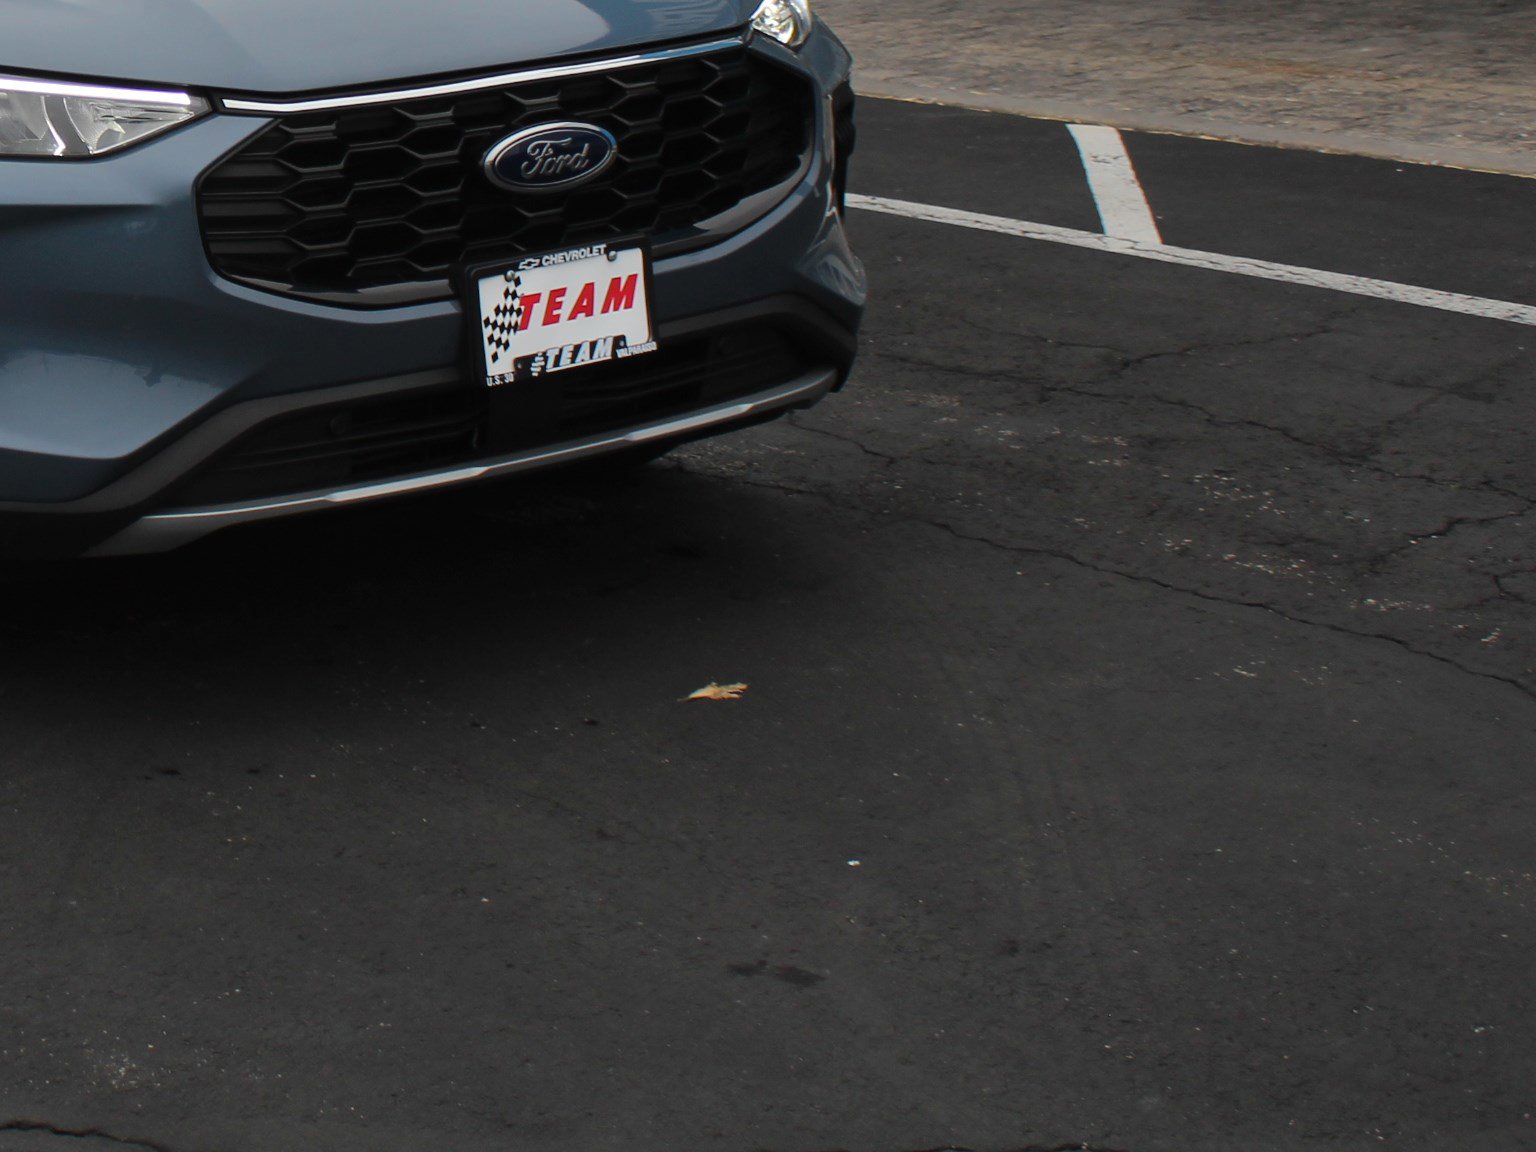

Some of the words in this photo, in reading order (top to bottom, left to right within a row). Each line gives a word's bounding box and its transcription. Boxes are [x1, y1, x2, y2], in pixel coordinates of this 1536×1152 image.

[520, 136, 590, 179] Ford
[541, 244, 607, 267] CHEVROLET
[517, 273, 639, 332] TEAM
[545, 336, 614, 371] TEAM
